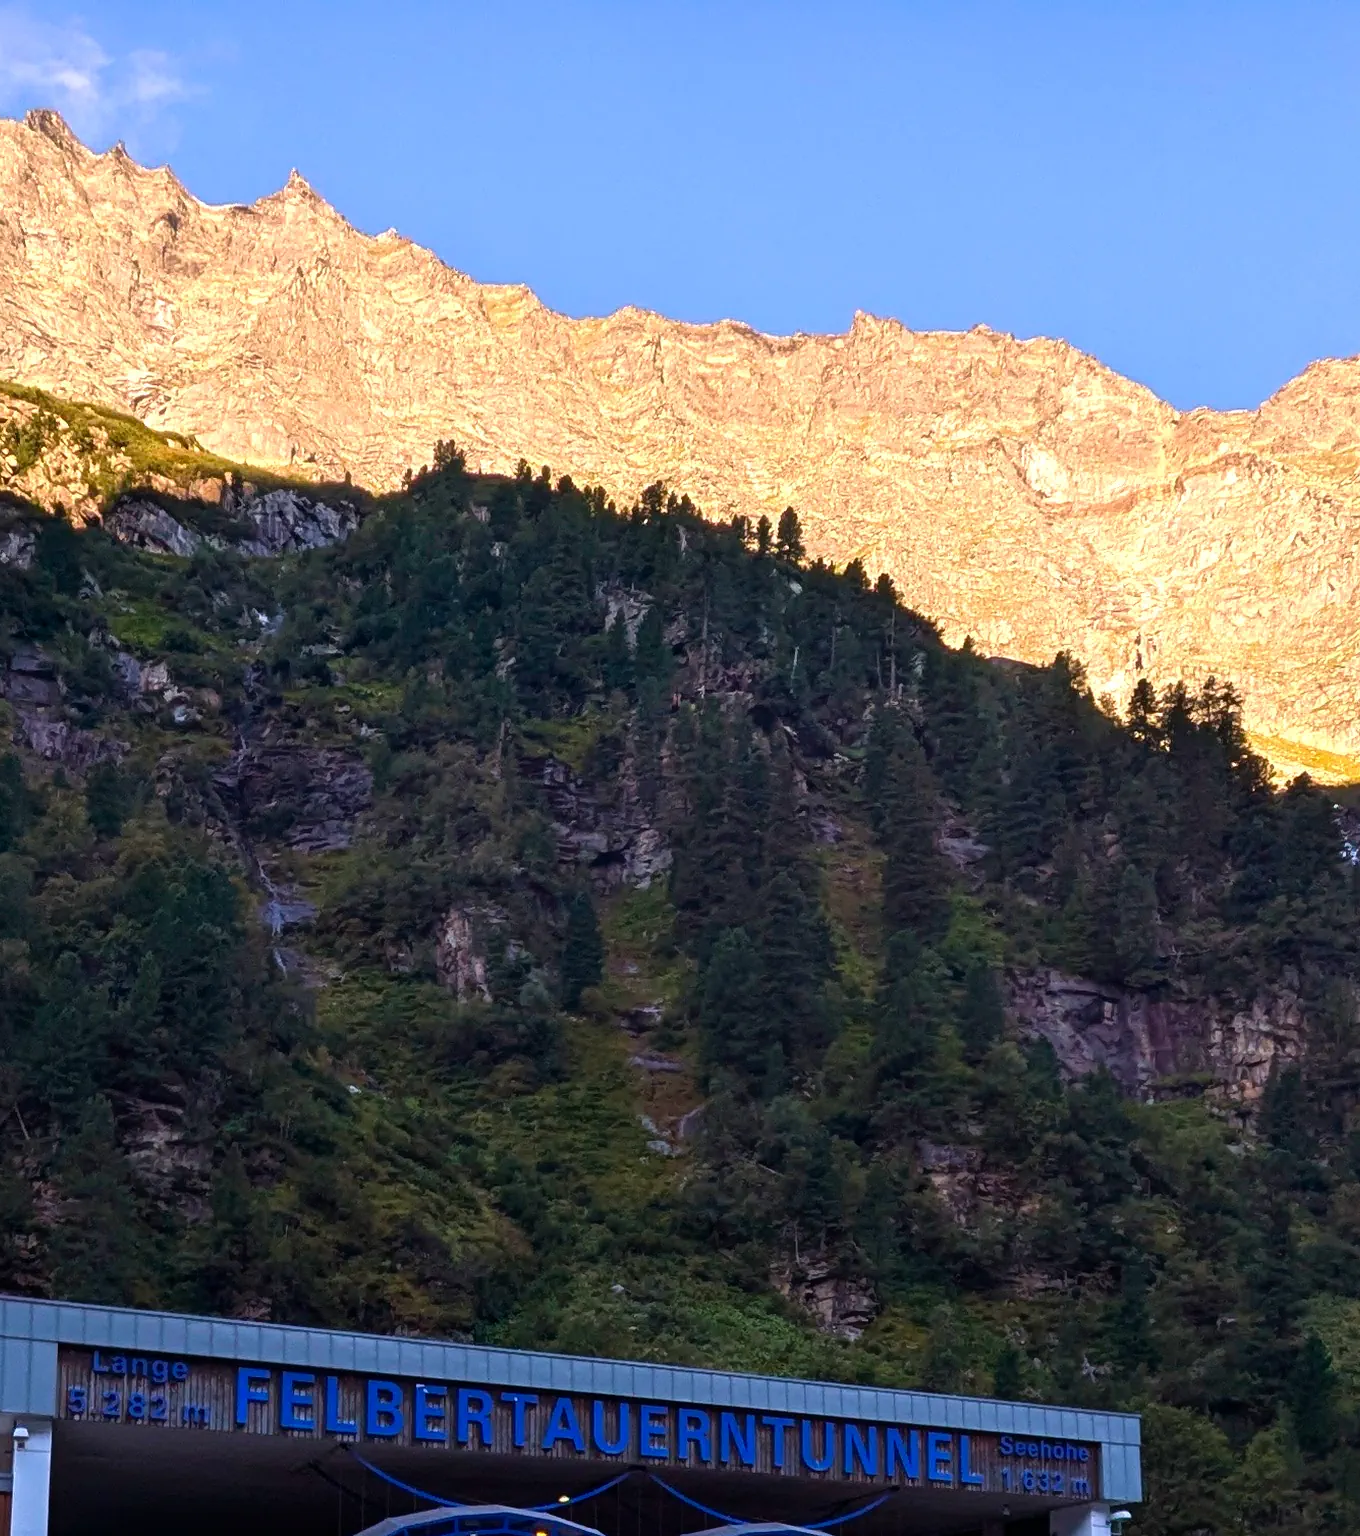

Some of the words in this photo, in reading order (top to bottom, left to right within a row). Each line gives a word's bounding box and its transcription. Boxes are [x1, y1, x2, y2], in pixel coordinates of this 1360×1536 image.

[183, 1404, 211, 1424] m
[236, 1366, 985, 1484] FELBERTAUERNTUNNEL
[1000, 1435, 1089, 1462] Seehöhe
[1071, 1477, 1090, 1496] m
